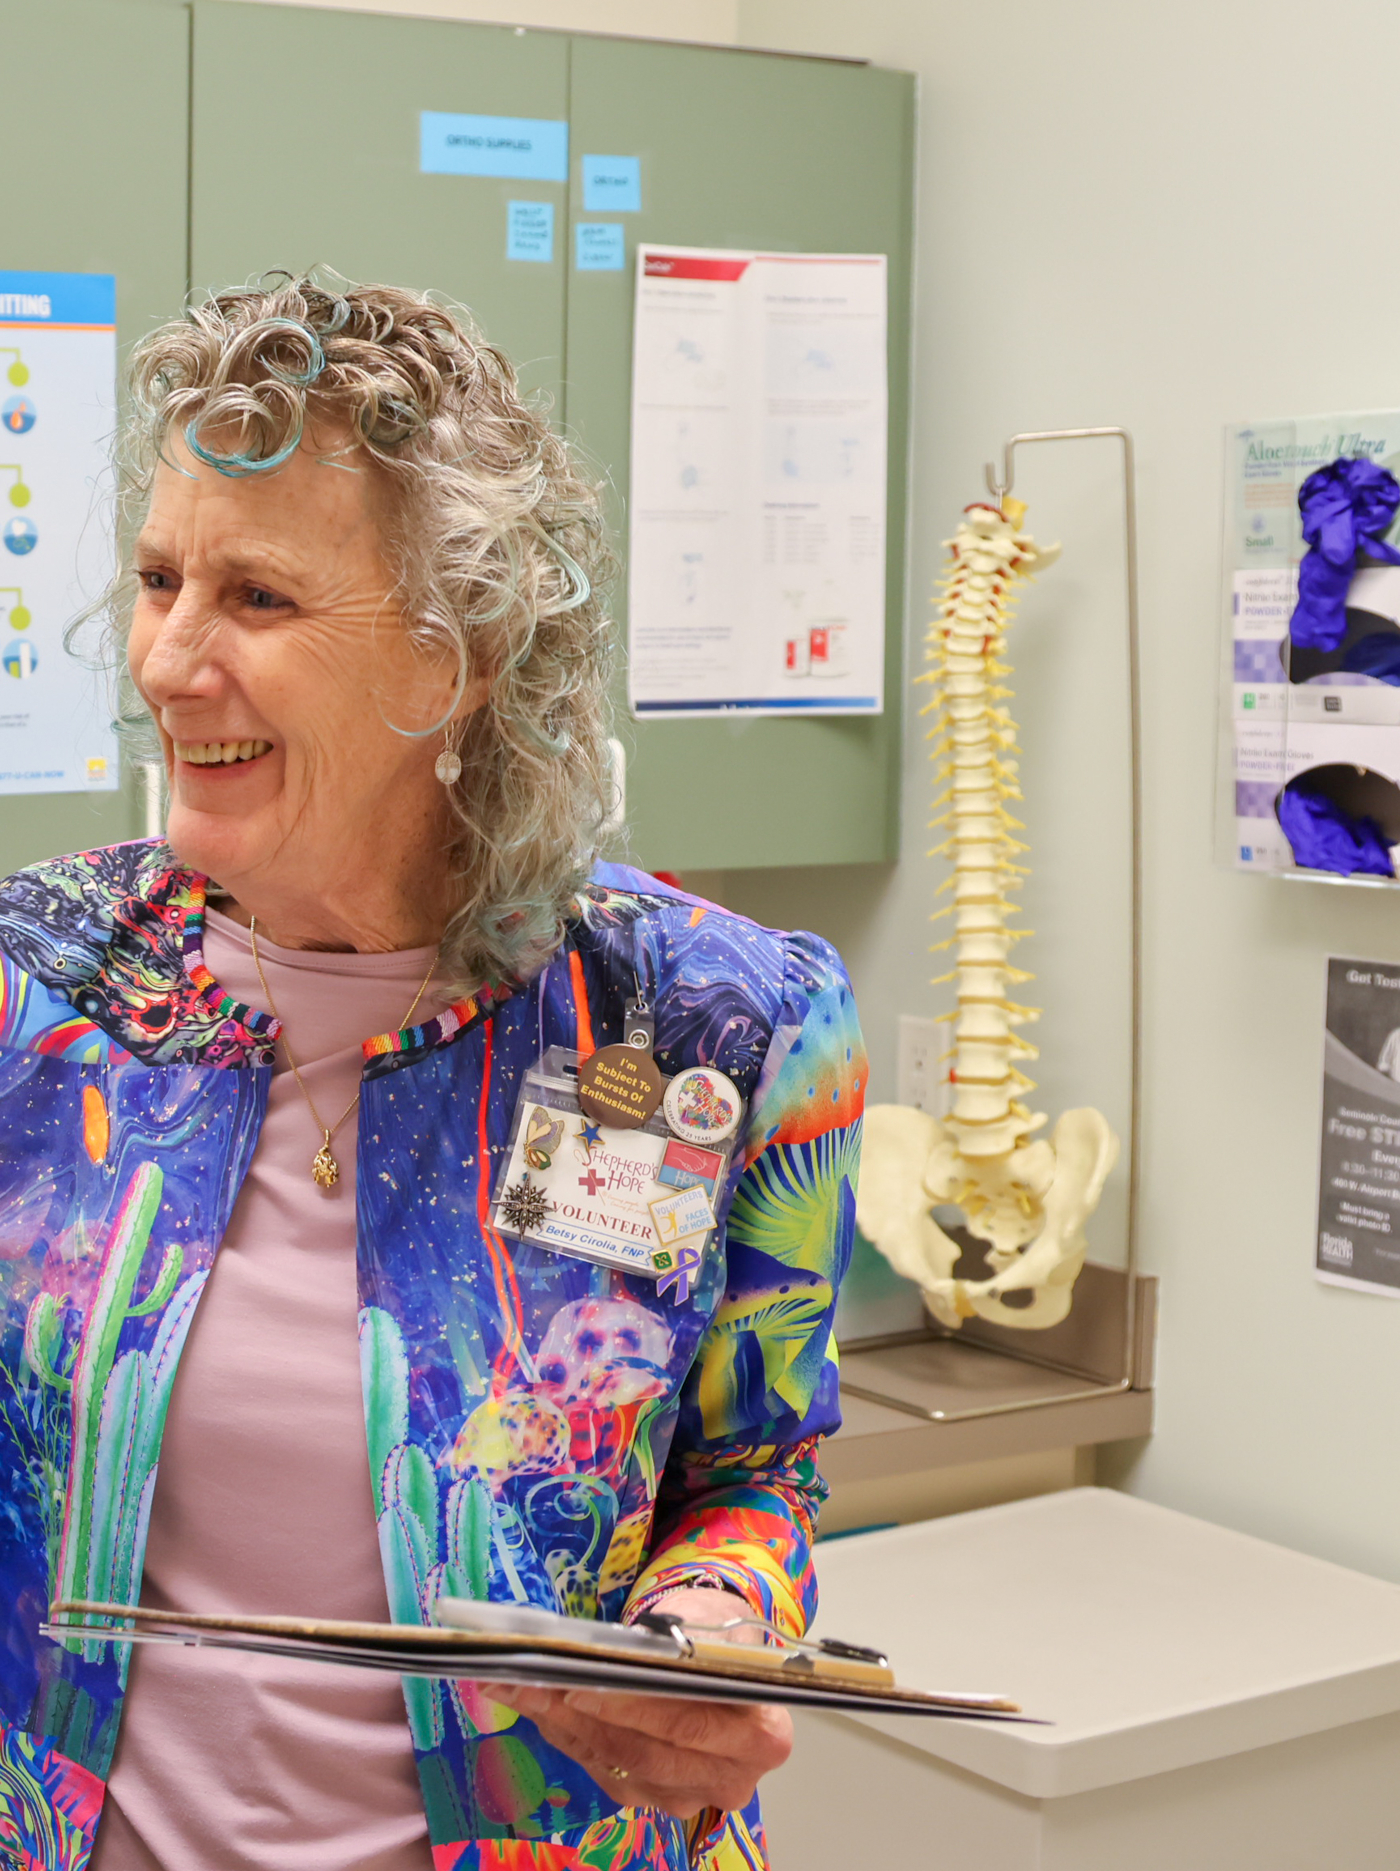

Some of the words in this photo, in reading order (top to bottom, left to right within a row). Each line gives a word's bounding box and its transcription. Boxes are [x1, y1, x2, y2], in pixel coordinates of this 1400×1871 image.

[1246, 435, 1332, 461] Aloetouch
[1336, 432, 1386, 454] Ultra
[1245, 536, 1274, 547] Small
[1287, 749, 1314, 760] Gloves
[1346, 969, 1372, 984] Get
[1373, 973, 1400, 989] Tes
[619, 1058, 638, 1072] I'm
[596, 1062, 637, 1087] Subject
[639, 1080, 651, 1093] To
[594, 1076, 629, 1097] Bursts
[630, 1091, 644, 1104] Of
[580, 1084, 647, 1120] Enthusiasm!
[666, 1099, 686, 1134] CELEBRATING
[1338, 1106, 1379, 1122] Seminole
[1328, 1118, 1367, 1141] Free
[1331, 1177, 1348, 1188] 400
[1349, 1180, 1359, 1191] W.
[1360, 1183, 1391, 1198] Airport
[655, 1190, 704, 1216] VOLUNTEERS
[1340, 1201, 1362, 1214] Must
[1362, 1206, 1383, 1221] bring
[1384, 1212, 1391, 1221] a
[552, 1200, 652, 1240] VOLUNTEER
[684, 1207, 709, 1222] FACES
[1336, 1213, 1357, 1225] valid
[1358, 1218, 1381, 1230] photo
[678, 1223, 691, 1234] OF
[691, 1216, 712, 1230] HOPE
[545, 1225, 577, 1241] Betsy
[579, 1234, 618, 1253] Cirolia,
[621, 1246, 645, 1258] FNP
[1321, 1232, 1353, 1248] Florida
[1322, 1243, 1353, 1260] HEALTH
